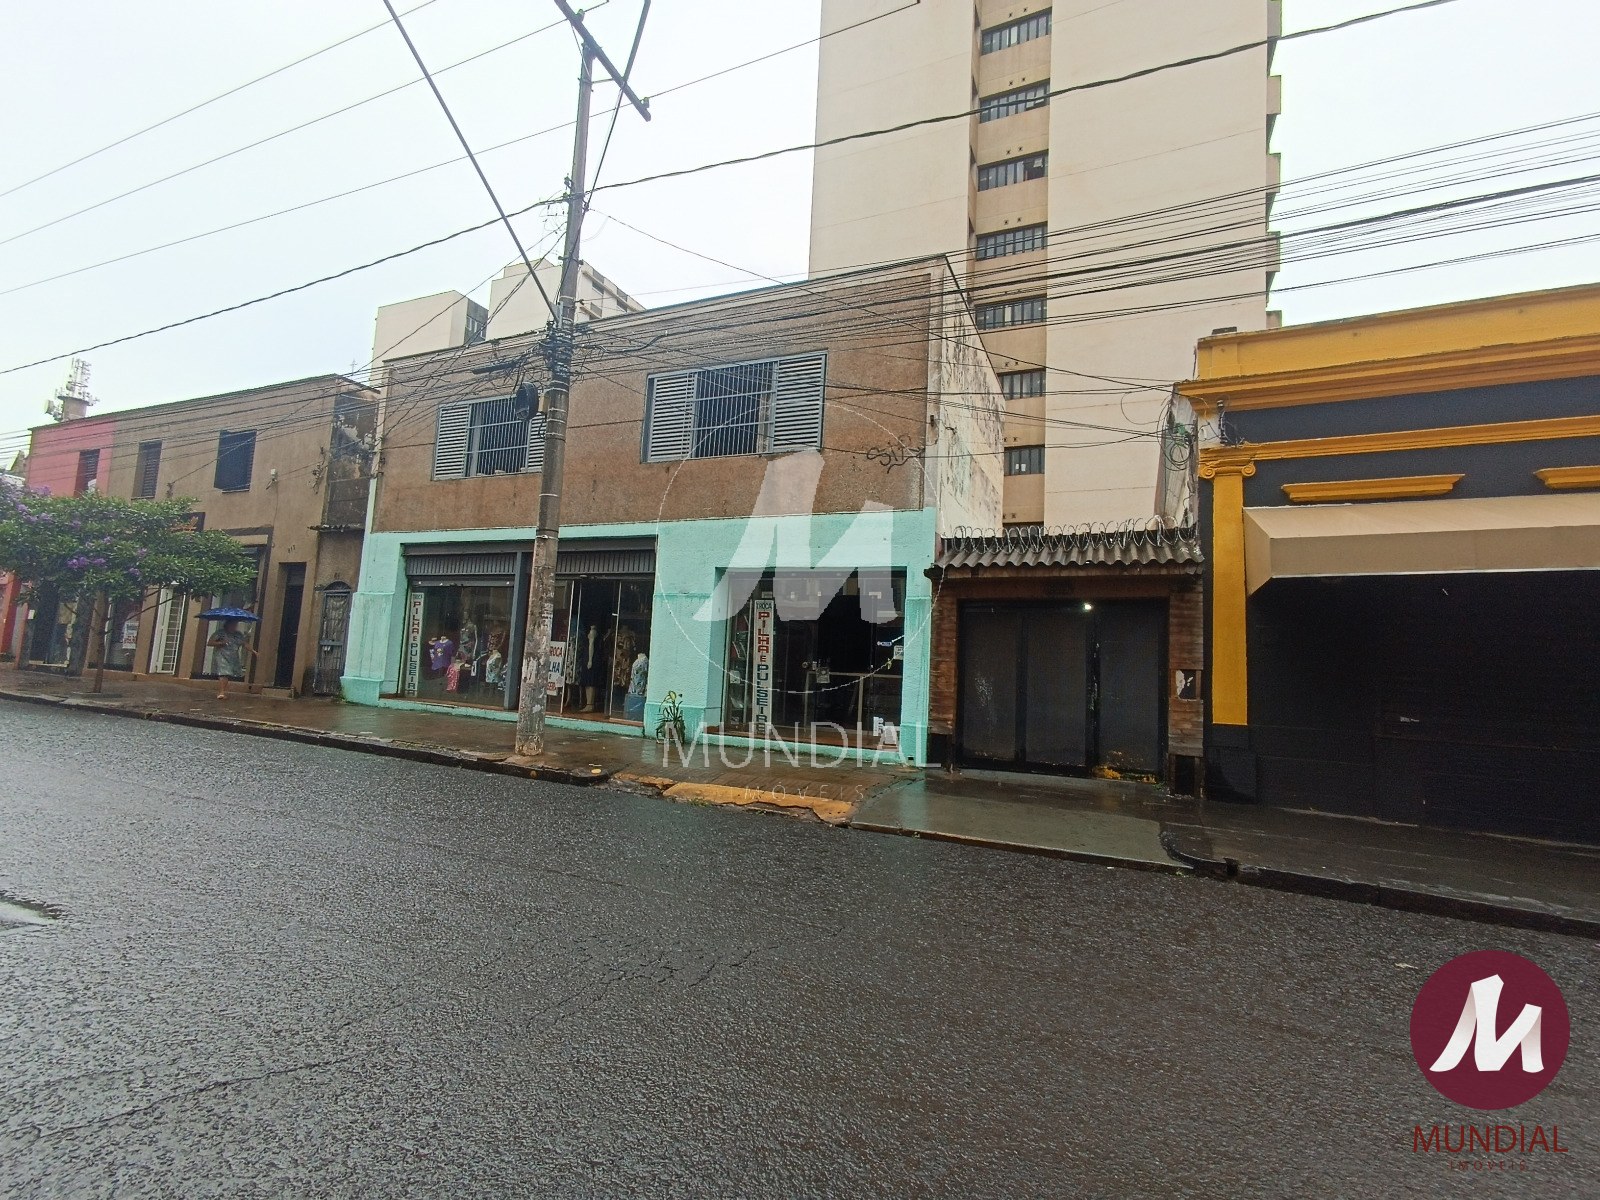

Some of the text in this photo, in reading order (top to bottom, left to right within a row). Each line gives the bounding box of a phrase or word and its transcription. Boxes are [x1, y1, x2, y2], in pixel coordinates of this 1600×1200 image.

[412, 601, 421, 635] PILHA
[756, 602, 773, 610] TROCA
[758, 612, 770, 653] PILHA
[756, 664, 769, 734] PULSEIRA
